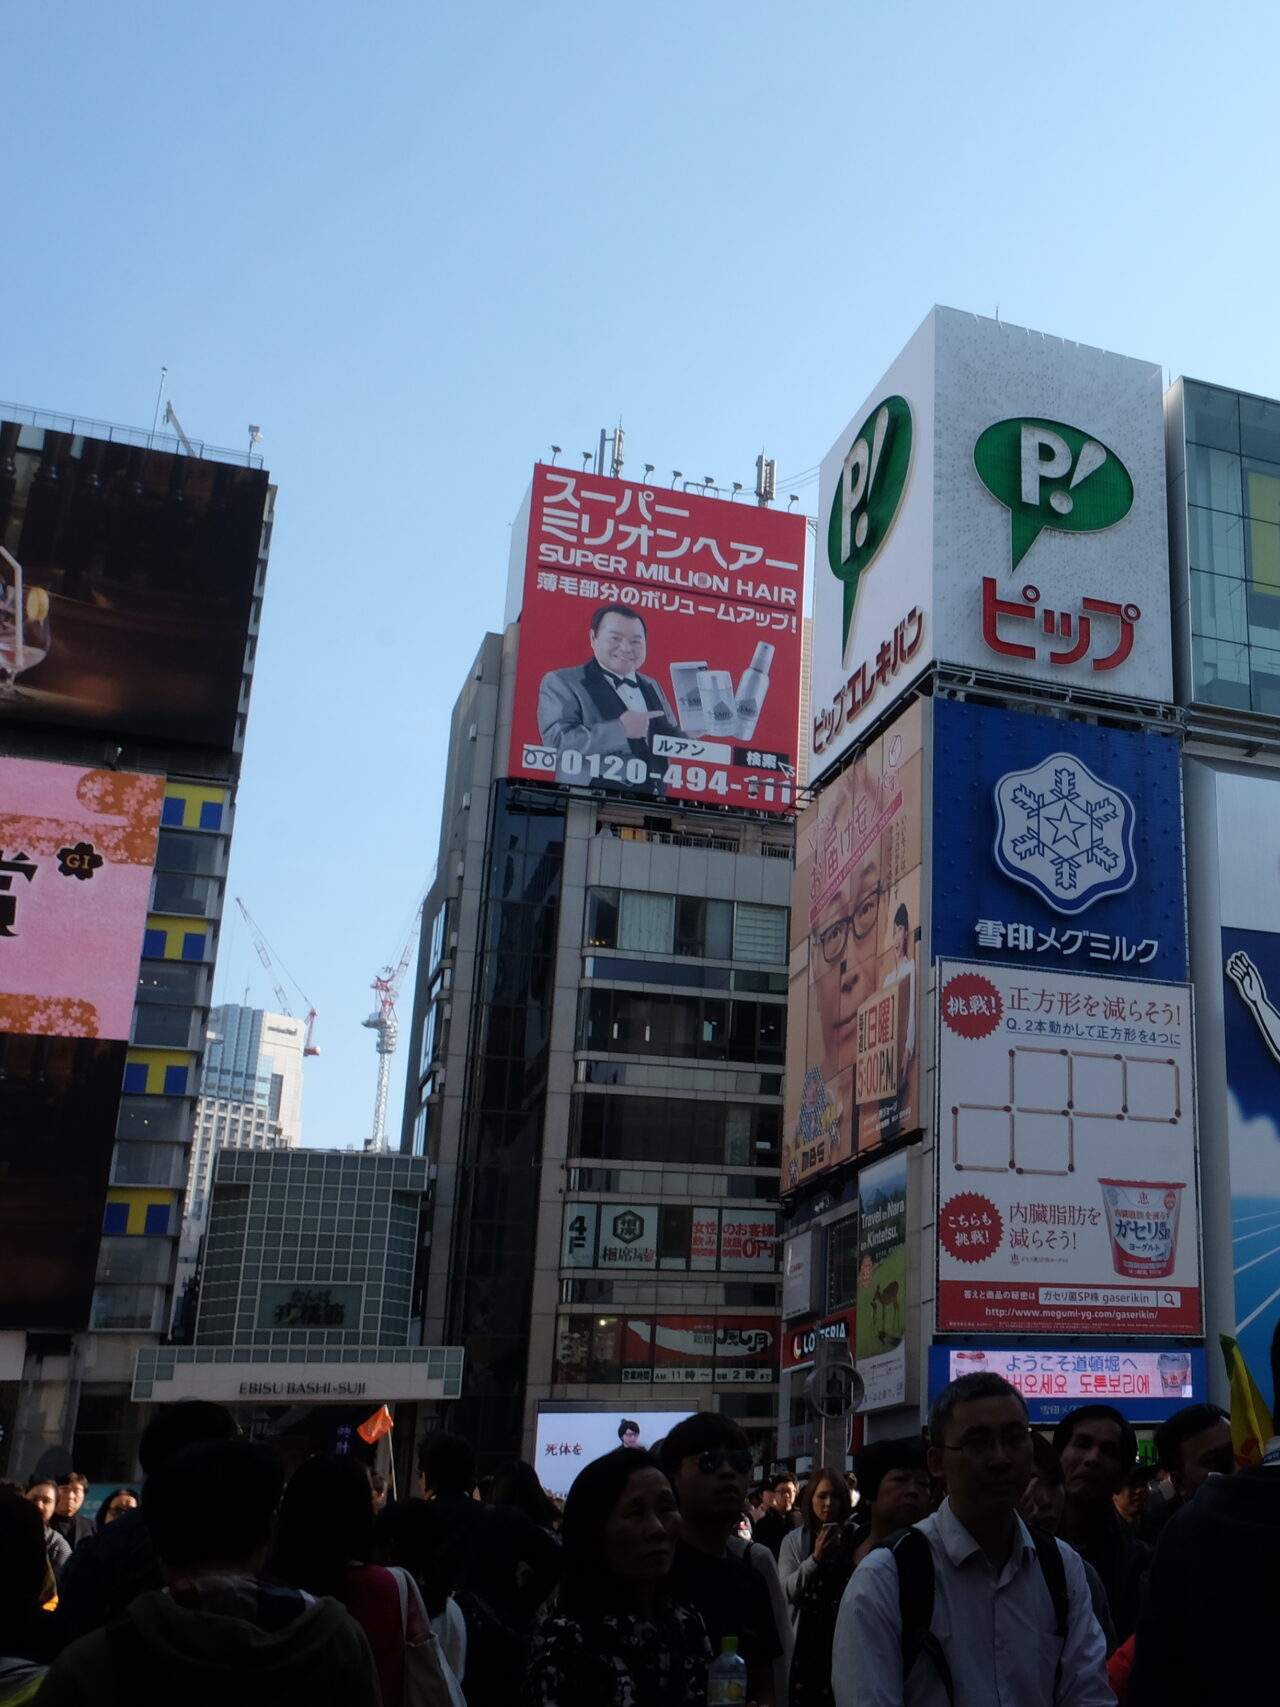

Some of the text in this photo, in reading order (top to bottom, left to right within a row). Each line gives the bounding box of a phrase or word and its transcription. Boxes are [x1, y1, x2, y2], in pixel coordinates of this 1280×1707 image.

[544, 473, 690, 522] スーパー
[541, 507, 799, 571] ミリオンヘアー
[539, 544, 797, 606] SUPER MILLION HAIR
[537, 572, 798, 633] 薄毛部分のボリュームアップ!
[982, 576, 1142, 672] ピップ
[813, 604, 925, 755] ピップエレキバン
[658, 740, 777, 769] ルアン 検索
[974, 919, 1160, 964] 雪印メグミルク
[946, 986, 1181, 1026] 挑戦! 正方形を減らそう!
[861, 1206, 882, 1229] Travel
[887, 1200, 905, 1217] Nara
[948, 1212, 992, 1229] こちらも
[1009, 1202, 1101, 1226] 内臓脂肪を
[954, 1230, 990, 1247] 挑戦!
[1009, 1229, 1077, 1251] 減らそう!
[1044, 1291, 1099, 1301] ガセリ菌SP株
[1102, 1293, 1149, 1305] gaserikin
[985, 1306, 1158, 1320] http://www.megumi-yg.com/gaserikin/
[803, 1321, 846, 1353] LOTERIA
[1006, 1354, 1138, 1372] ようこそ道頓堀へ
[239, 1382, 366, 1396] EBISU BASHI-SUJI
[1080, 1374, 1150, 1394] 도톤보리에
[544, 1443, 583, 1456] 死体を
